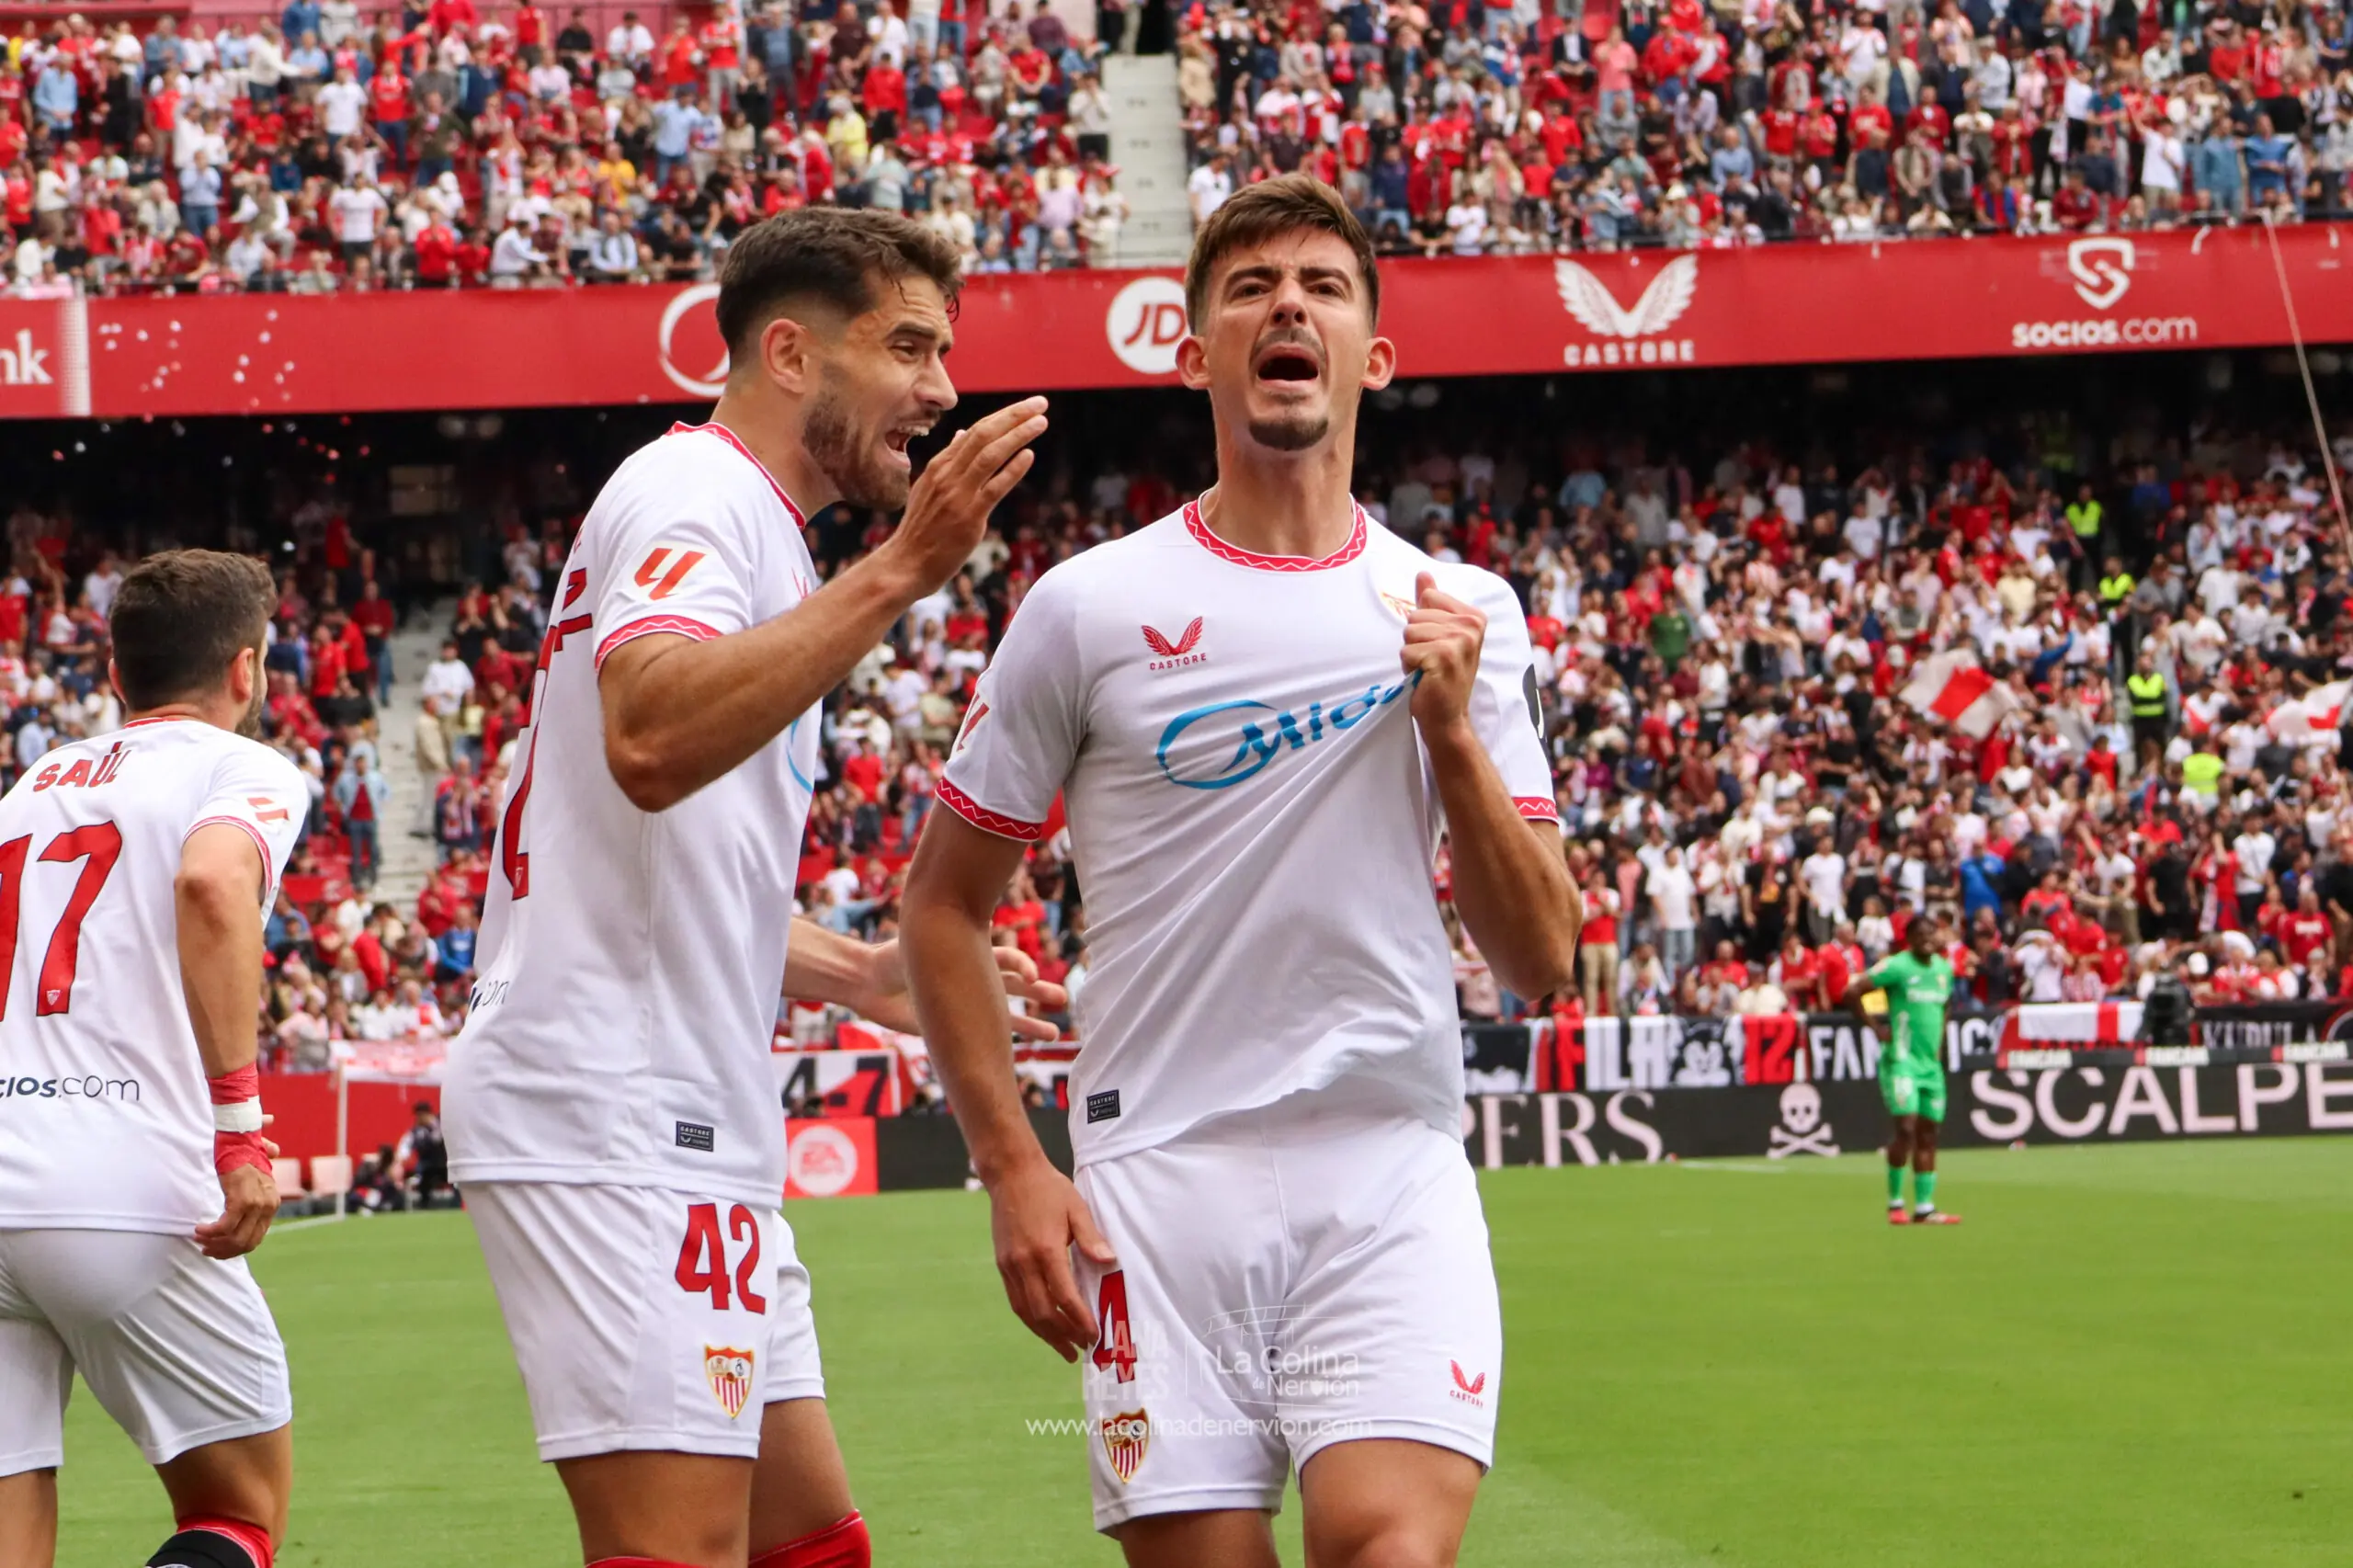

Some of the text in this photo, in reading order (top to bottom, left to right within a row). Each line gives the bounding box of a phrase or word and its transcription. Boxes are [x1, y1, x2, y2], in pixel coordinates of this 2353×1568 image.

[1124, 302, 1186, 346] JD
[1563, 339, 1696, 367] CASTORE
[1149, 653, 1207, 671] CASTORE
[33, 741, 131, 792] SAÚL
[1461, 1089, 1664, 1169] ERS
[675, 1202, 767, 1315] 42
